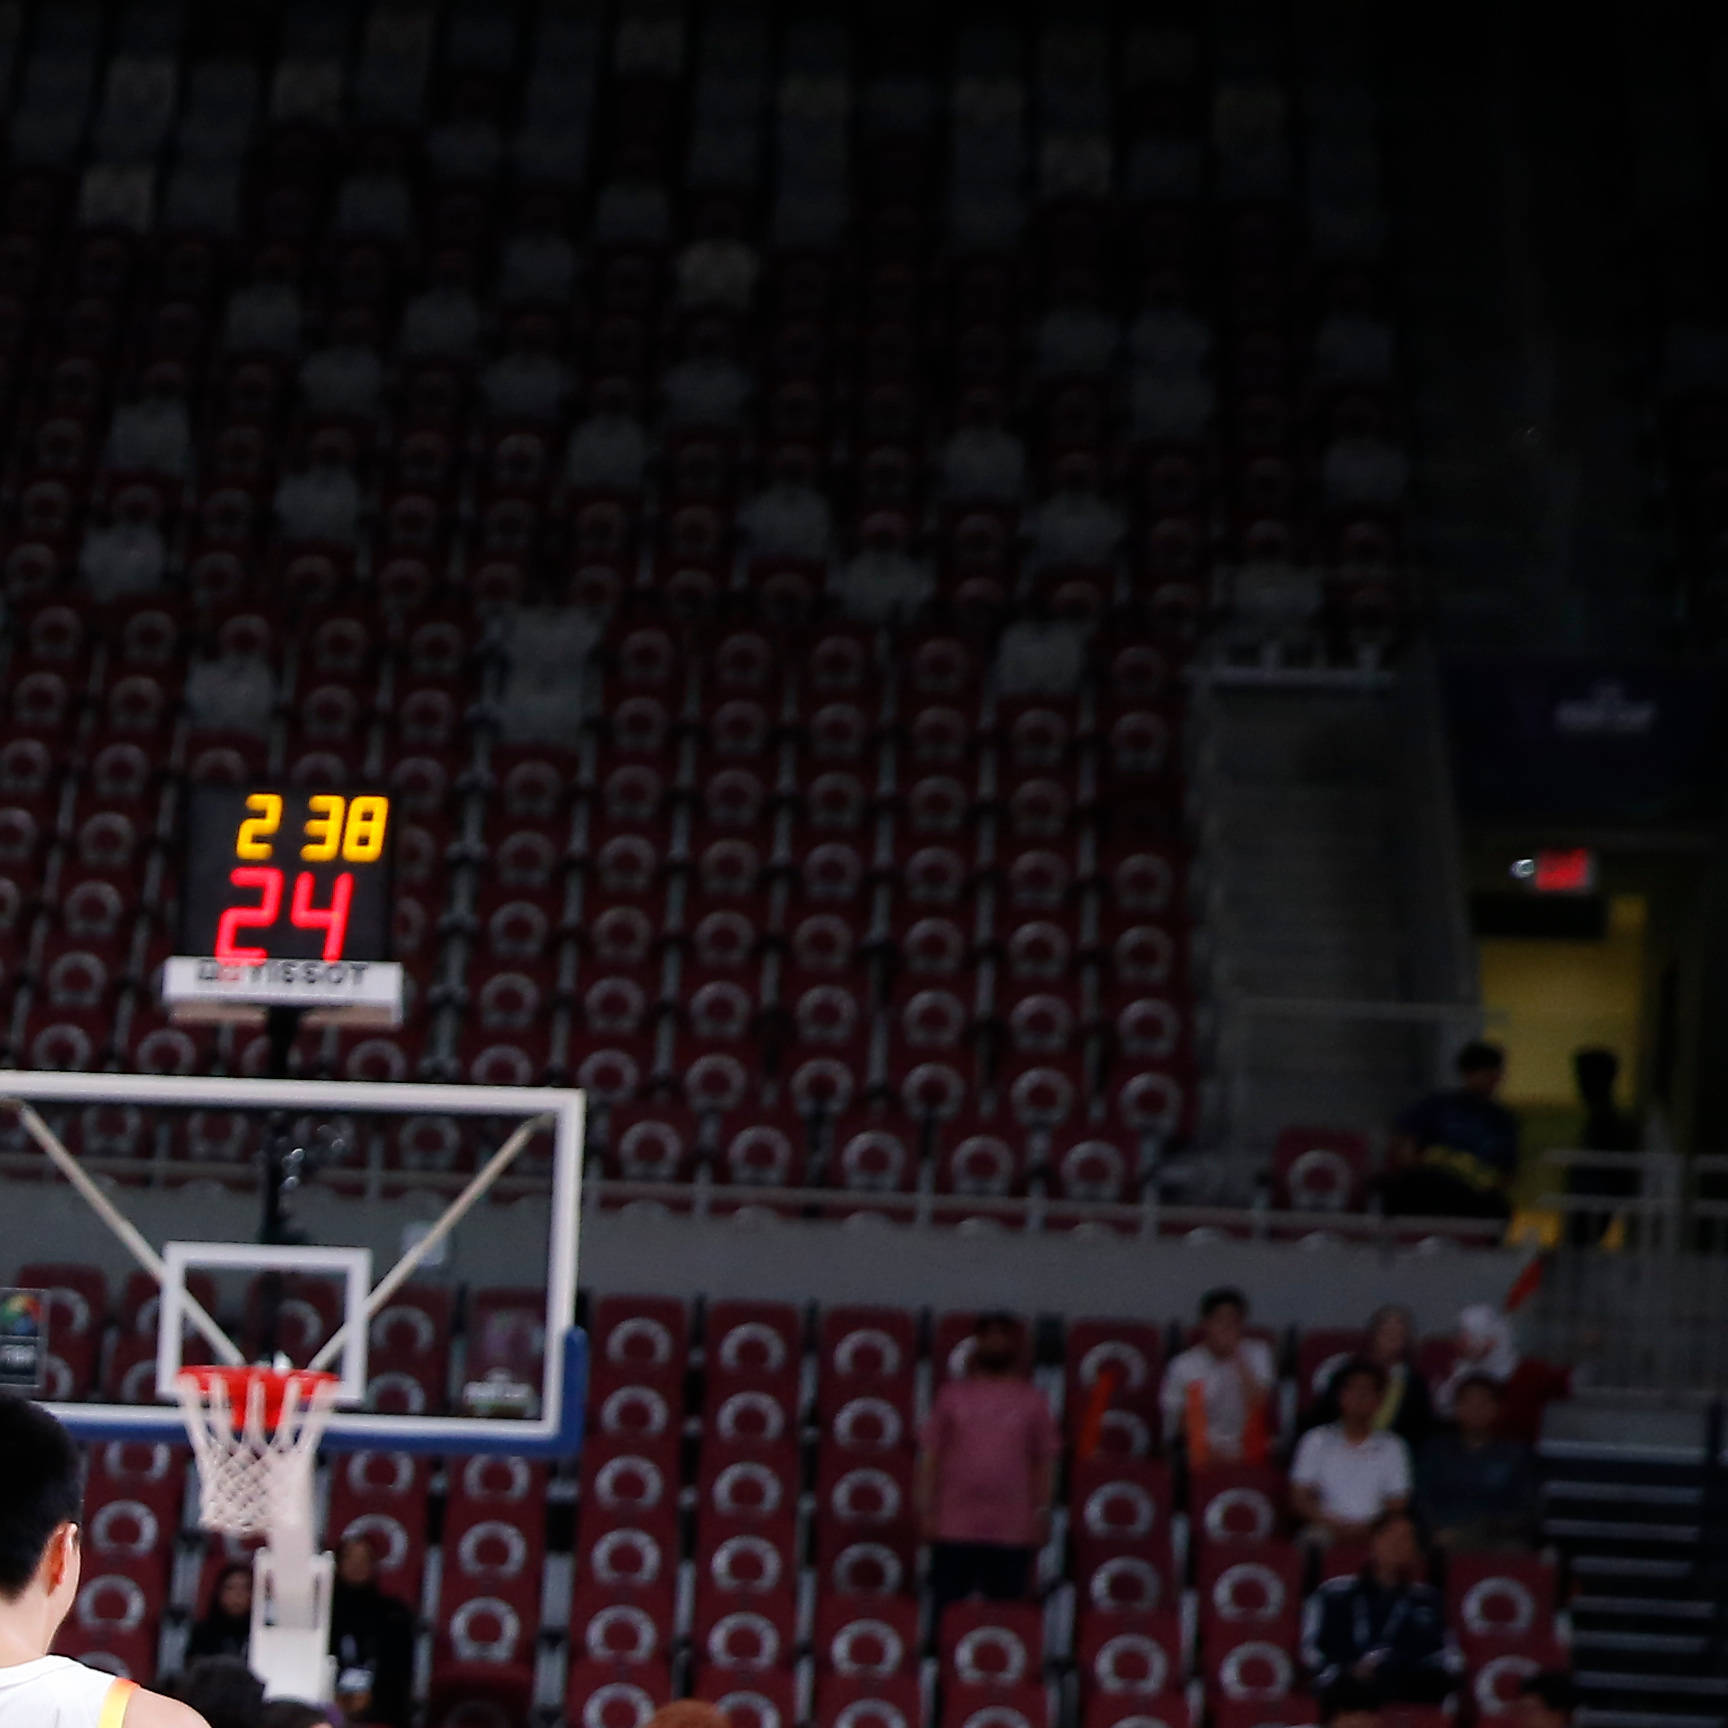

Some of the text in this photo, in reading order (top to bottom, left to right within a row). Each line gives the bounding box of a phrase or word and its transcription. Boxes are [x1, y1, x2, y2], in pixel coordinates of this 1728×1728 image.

[236, 793, 389, 862] 2 38
[214, 867, 354, 966] 24
